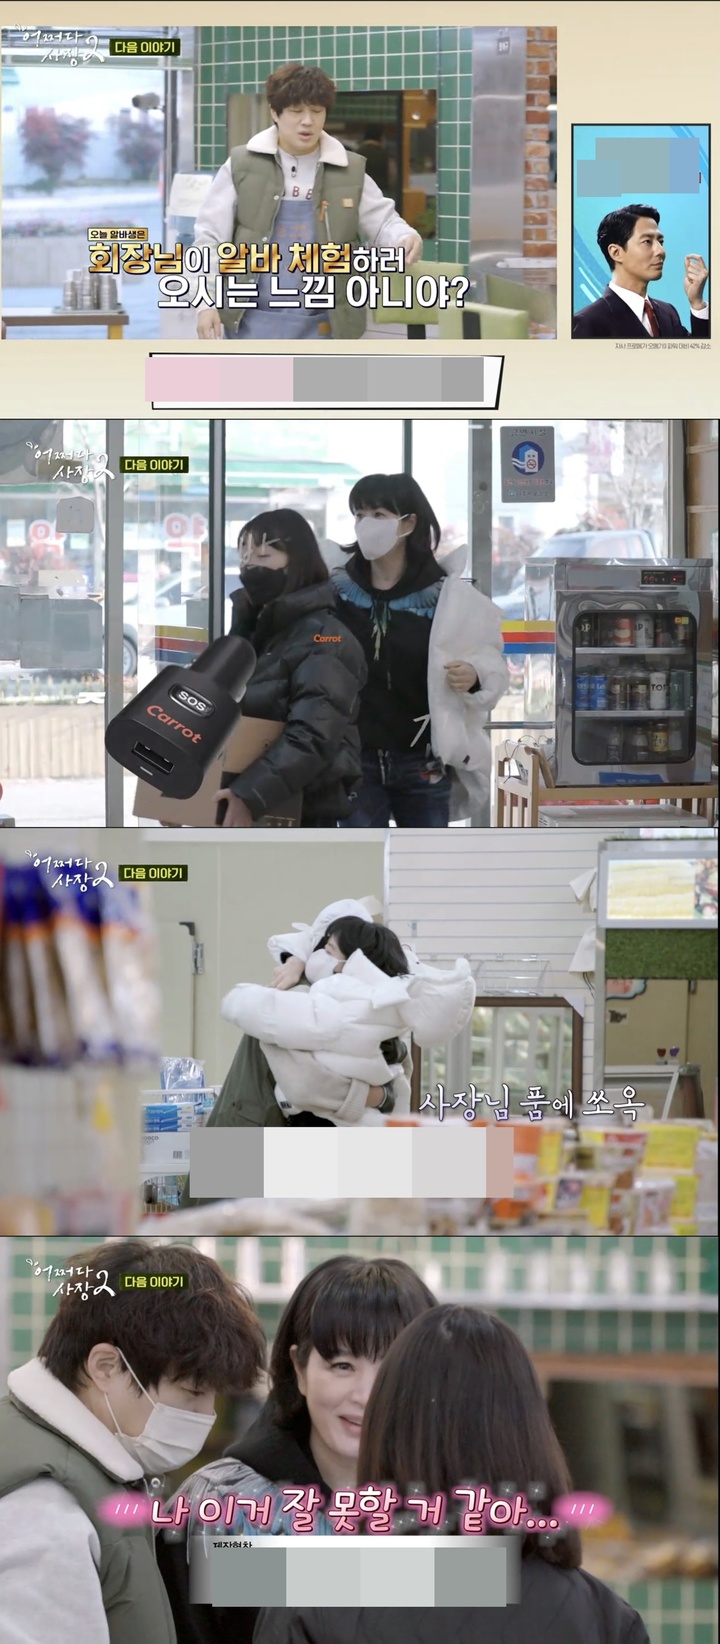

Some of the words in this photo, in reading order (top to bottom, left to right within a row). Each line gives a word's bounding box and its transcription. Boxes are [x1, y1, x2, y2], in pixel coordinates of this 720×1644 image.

[313, 633, 342, 643] Carrot
[178, 690, 207, 712] SOS
[146, 704, 202, 744] Carrot
